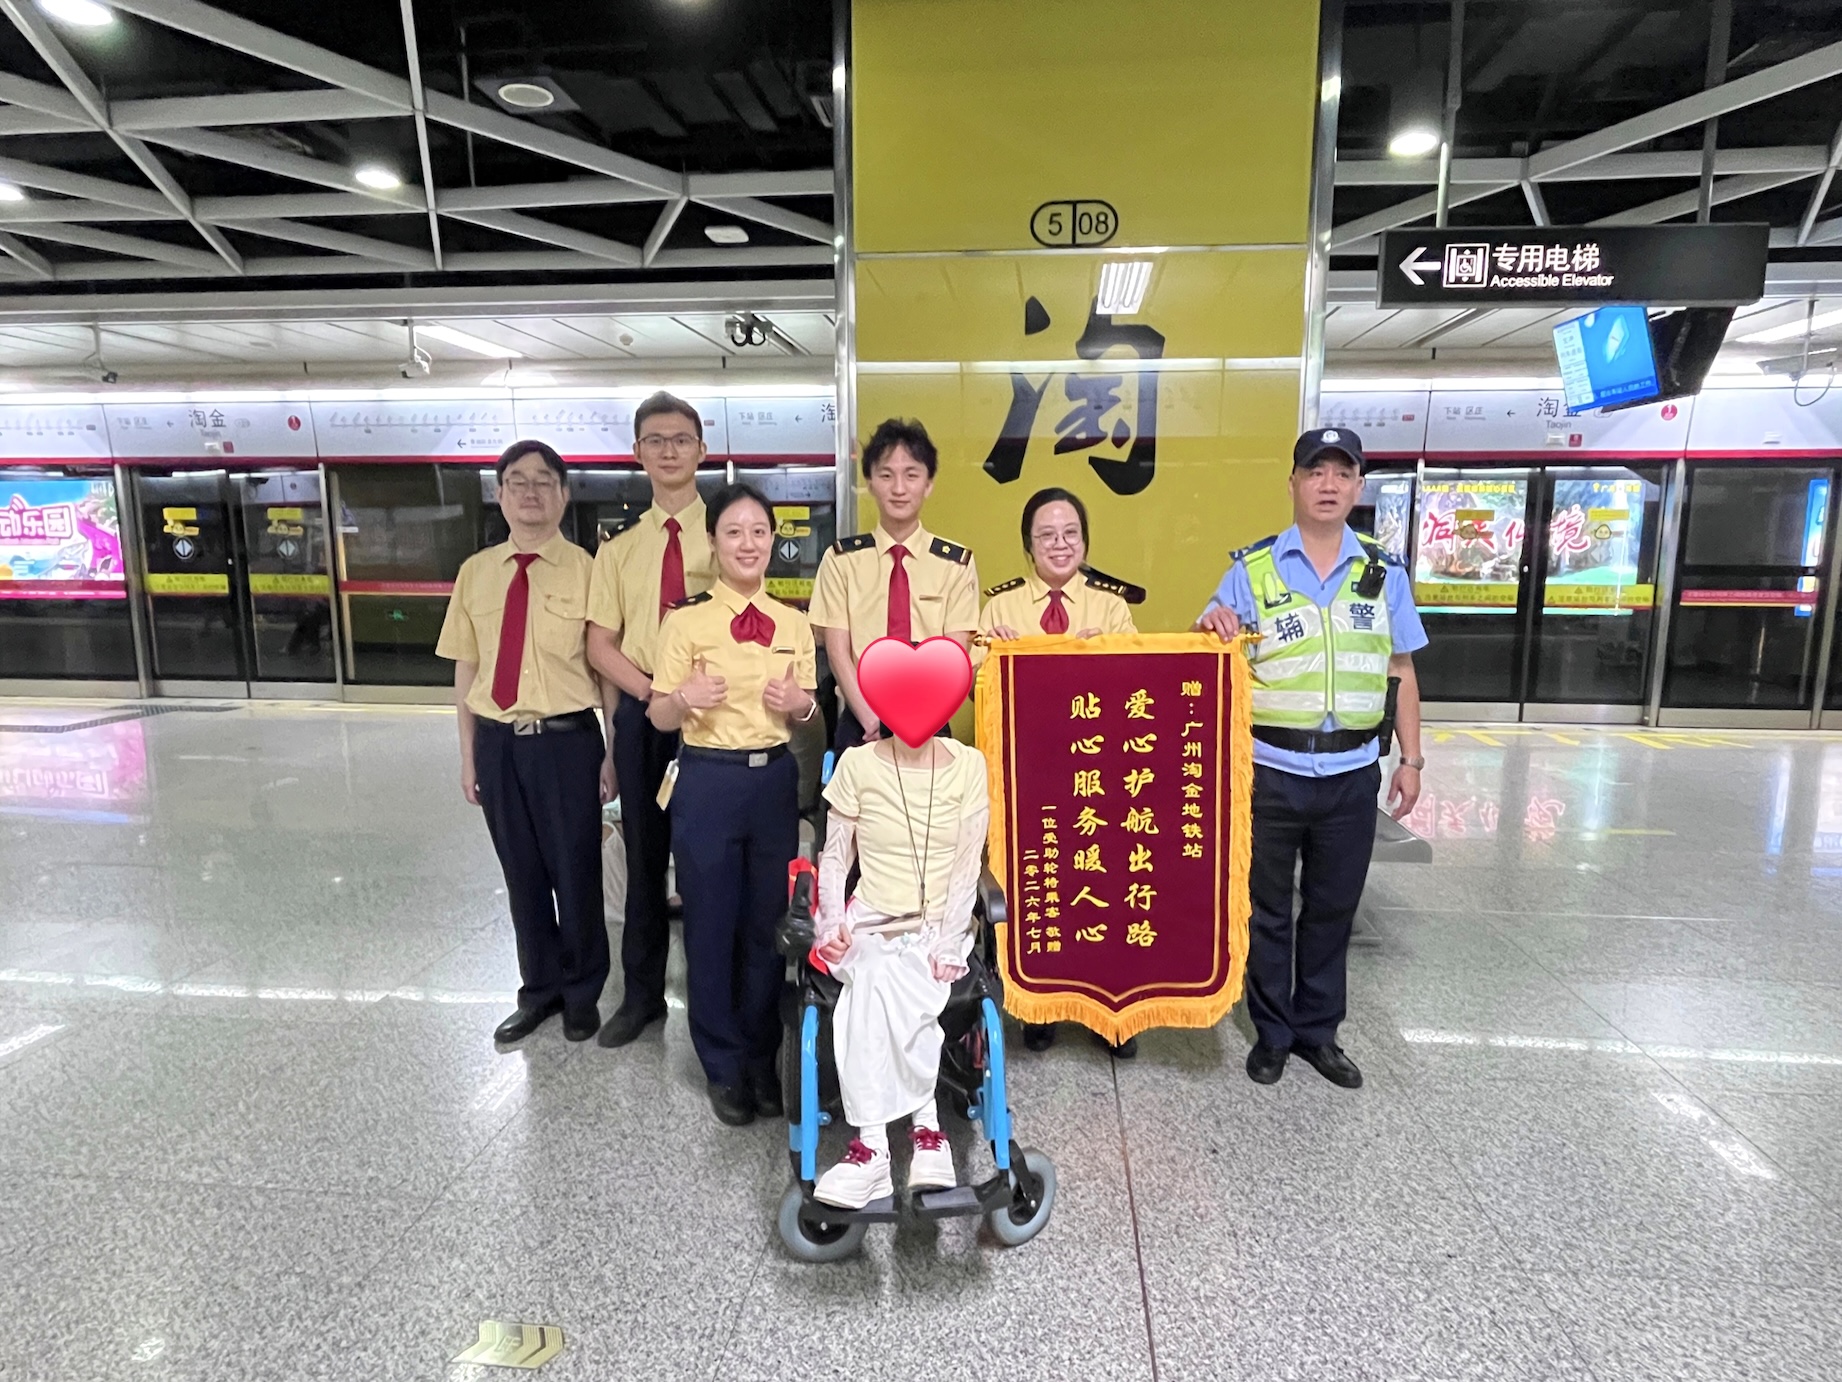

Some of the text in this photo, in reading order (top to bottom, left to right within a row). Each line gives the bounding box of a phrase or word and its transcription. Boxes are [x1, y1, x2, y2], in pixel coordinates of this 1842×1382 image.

[1048, 212, 1109, 236] 5 08
[1492, 243, 1600, 273] 专用电梯
[1490, 273, 1615, 288] Accessible Elevator
[983, 296, 1165, 495] 淘
[188, 409, 227, 429] 淘金
[1546, 420, 1572, 430] Taojin
[1275, 603, 1375, 642] 辅 警
[1070, 691, 1110, 943] 贴心服务暖人心
[1120, 688, 1160, 948] 爱心护航出行路
[1023, 850, 1042, 955] 二零二六年七月
